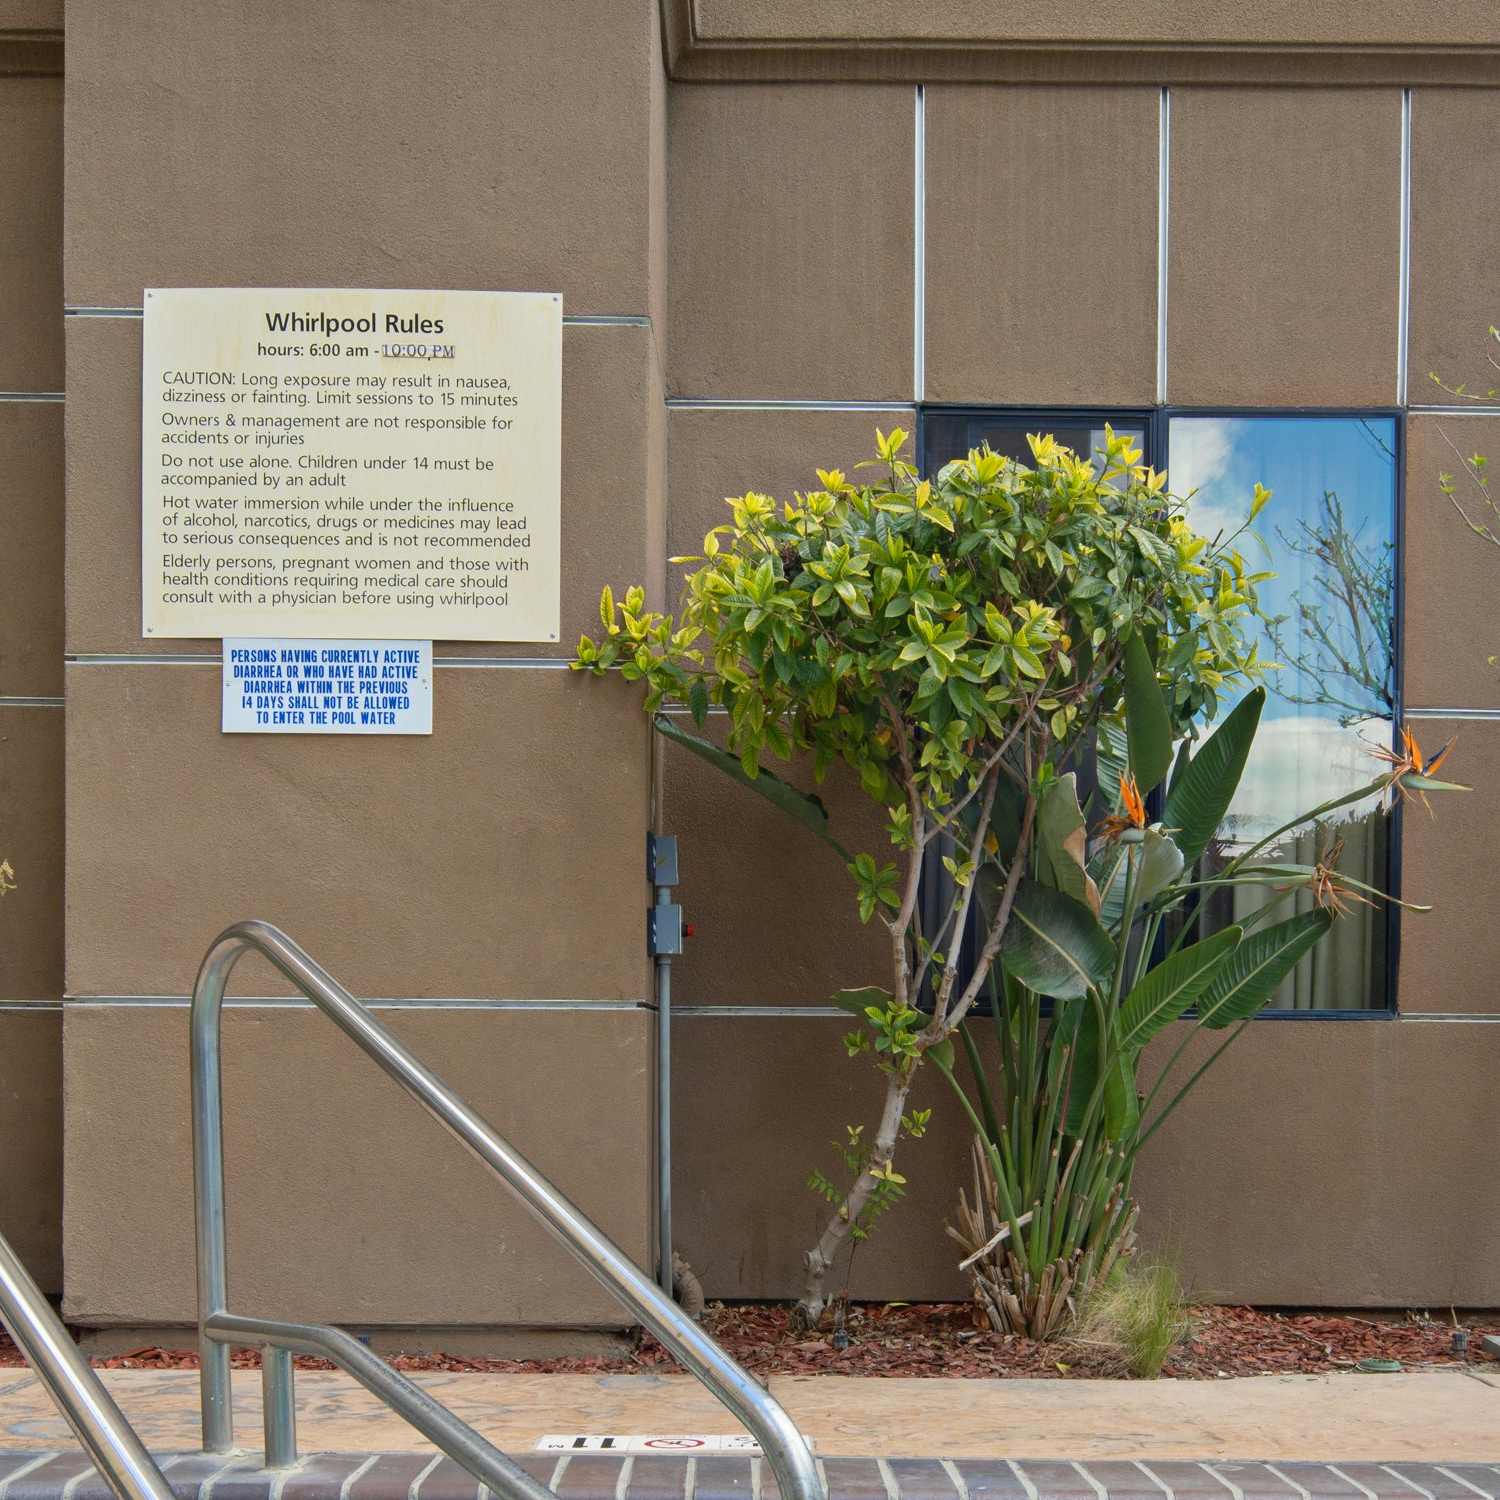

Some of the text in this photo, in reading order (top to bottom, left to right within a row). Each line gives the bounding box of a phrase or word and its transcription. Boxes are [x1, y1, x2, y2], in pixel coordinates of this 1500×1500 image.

[265, 311, 443, 337] Whirlpool Rules
[257, 342, 303, 356] hours:
[309, 343, 340, 356] 6:00
[345, 346, 368, 356] am
[382, 344, 427, 358] 10:00
[433, 345, 455, 358] PM
[162, 371, 510, 390] CAUTION: Long exposure may result in nausea,
[162, 388, 517, 407] dizziness or fainting. Limit sessions to 15 minutes
[161, 412, 513, 431] Owners & management are not responsible for
[161, 430, 304, 448] accidents or injuries
[161, 453, 493, 470] Do not use alone. Children under 14 must be
[160, 472, 346, 489] accompanied by an adult
[163, 495, 513, 512] Hot water immersion while under the influence
[162, 512, 526, 532] of alcohol, narcotics, drugs or medicines may lead
[162, 530, 530, 548] to serious consequences and is not recommended
[163, 554, 528, 573] Elderly persons, pregnant women and those with
[162, 572, 507, 591] health conditions requiring medical care should
[162, 589, 507, 608] consult with a physician before using whirlpool
[231, 649, 419, 663] PERSONS HAVING CURRENTLY ACTIVE
[233, 664, 417, 678] DIARRHEA OR WHO HAVE HAD ACTIVE
[244, 680, 407, 694] DIARRHEA WITHIN THE PREVIOUS
[242, 695, 409, 709] 14 DAYS SHALL NOT BE ALLOWED
[256, 711, 395, 724] TO ENTER THE POOL WATER
